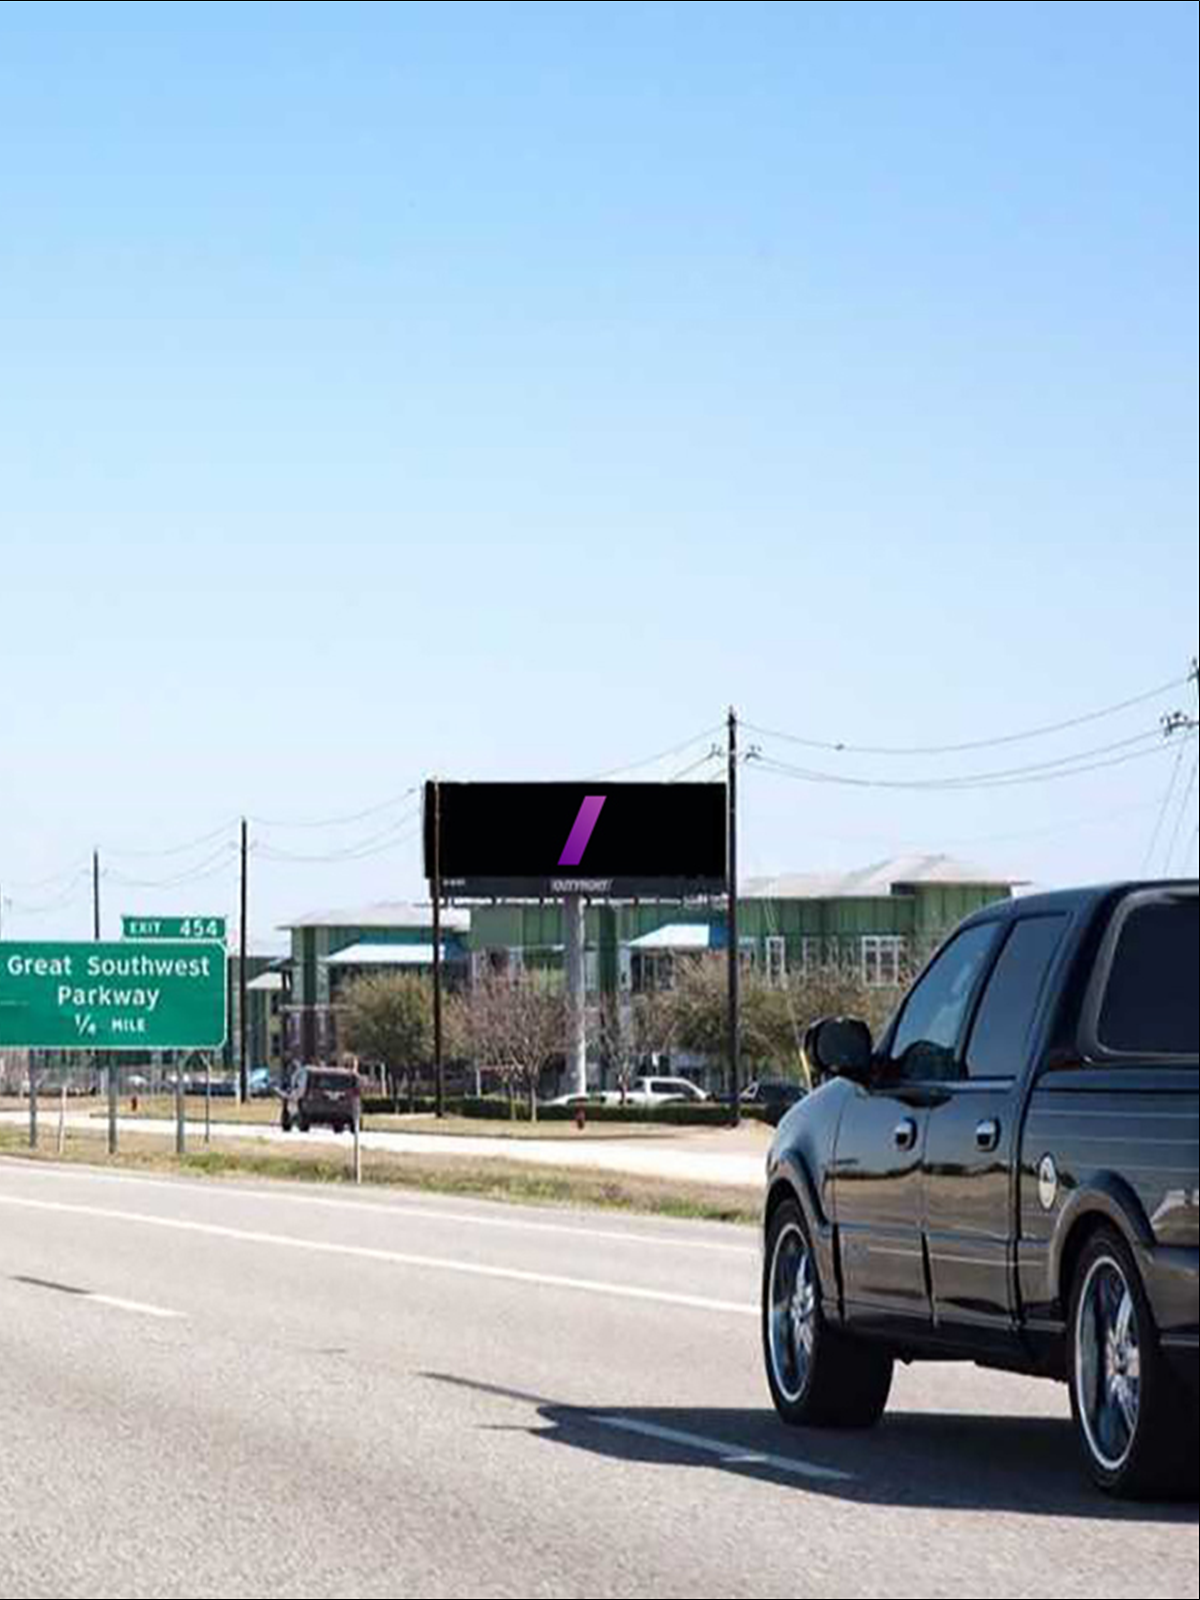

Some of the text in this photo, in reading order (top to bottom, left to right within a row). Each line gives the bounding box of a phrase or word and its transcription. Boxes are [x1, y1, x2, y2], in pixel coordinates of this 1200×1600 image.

[129, 919, 218, 936] EXIT 454
[6, 955, 210, 977] Great Southwest
[57, 985, 160, 1012] Parkway
[111, 1017, 146, 1033] MILE
